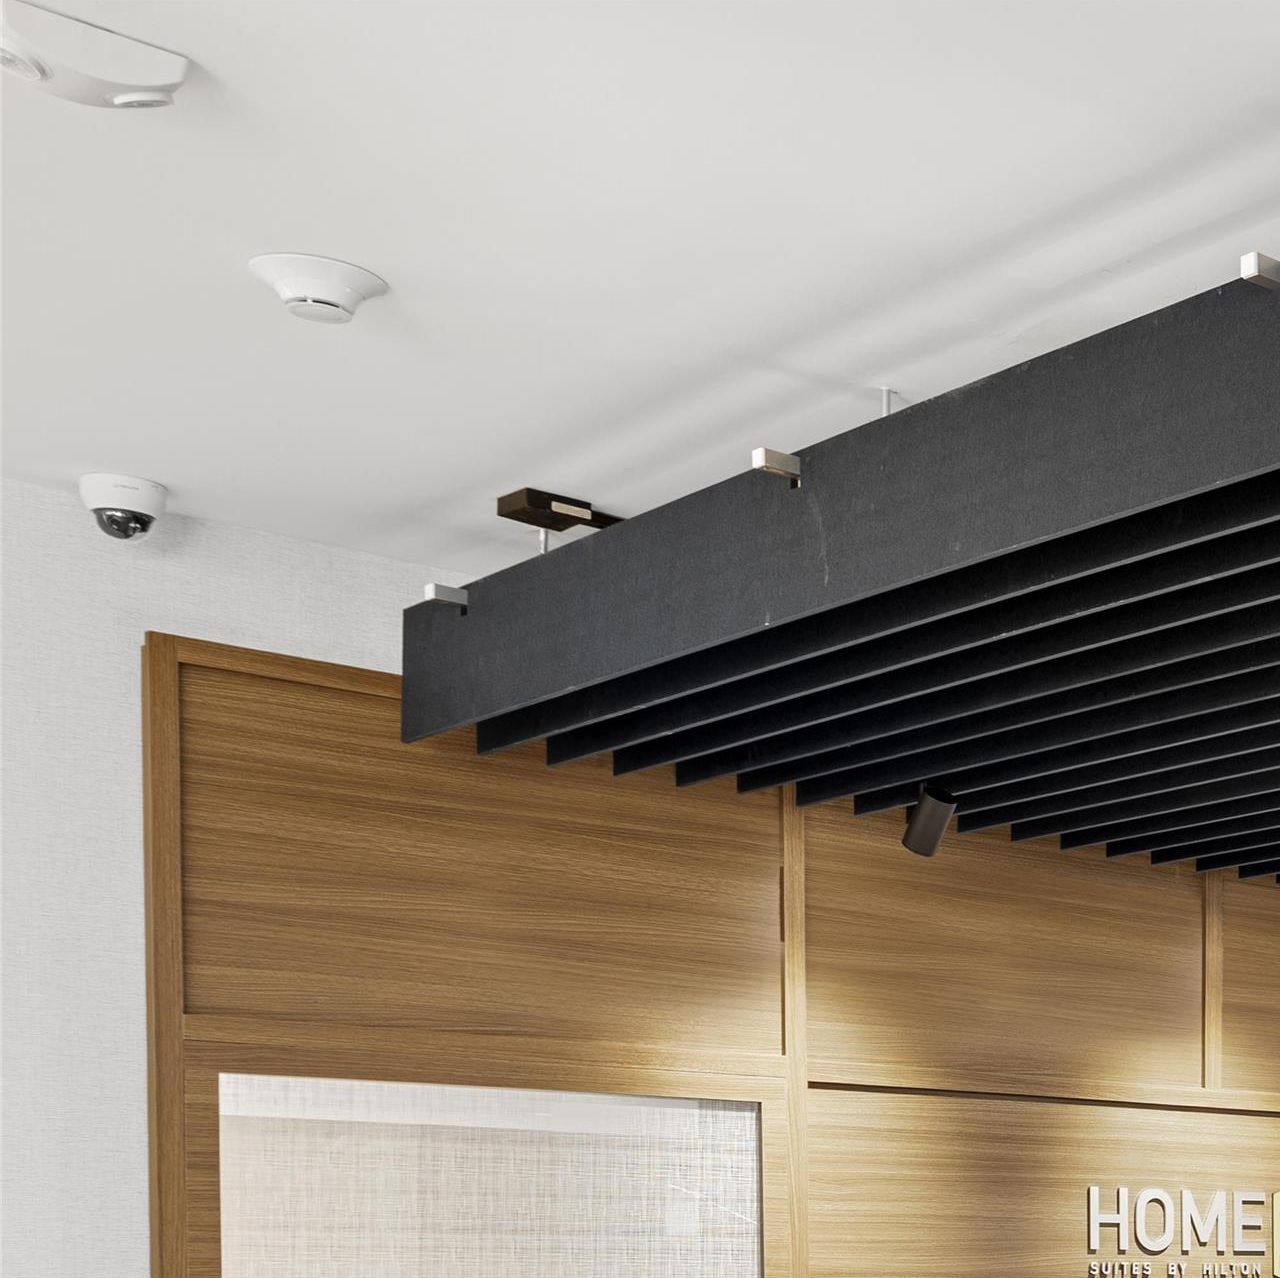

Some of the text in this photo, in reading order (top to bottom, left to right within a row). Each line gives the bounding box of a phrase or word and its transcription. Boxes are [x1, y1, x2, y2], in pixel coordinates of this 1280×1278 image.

[1089, 1261, 1262, 1278] SUITES BY HILTON
